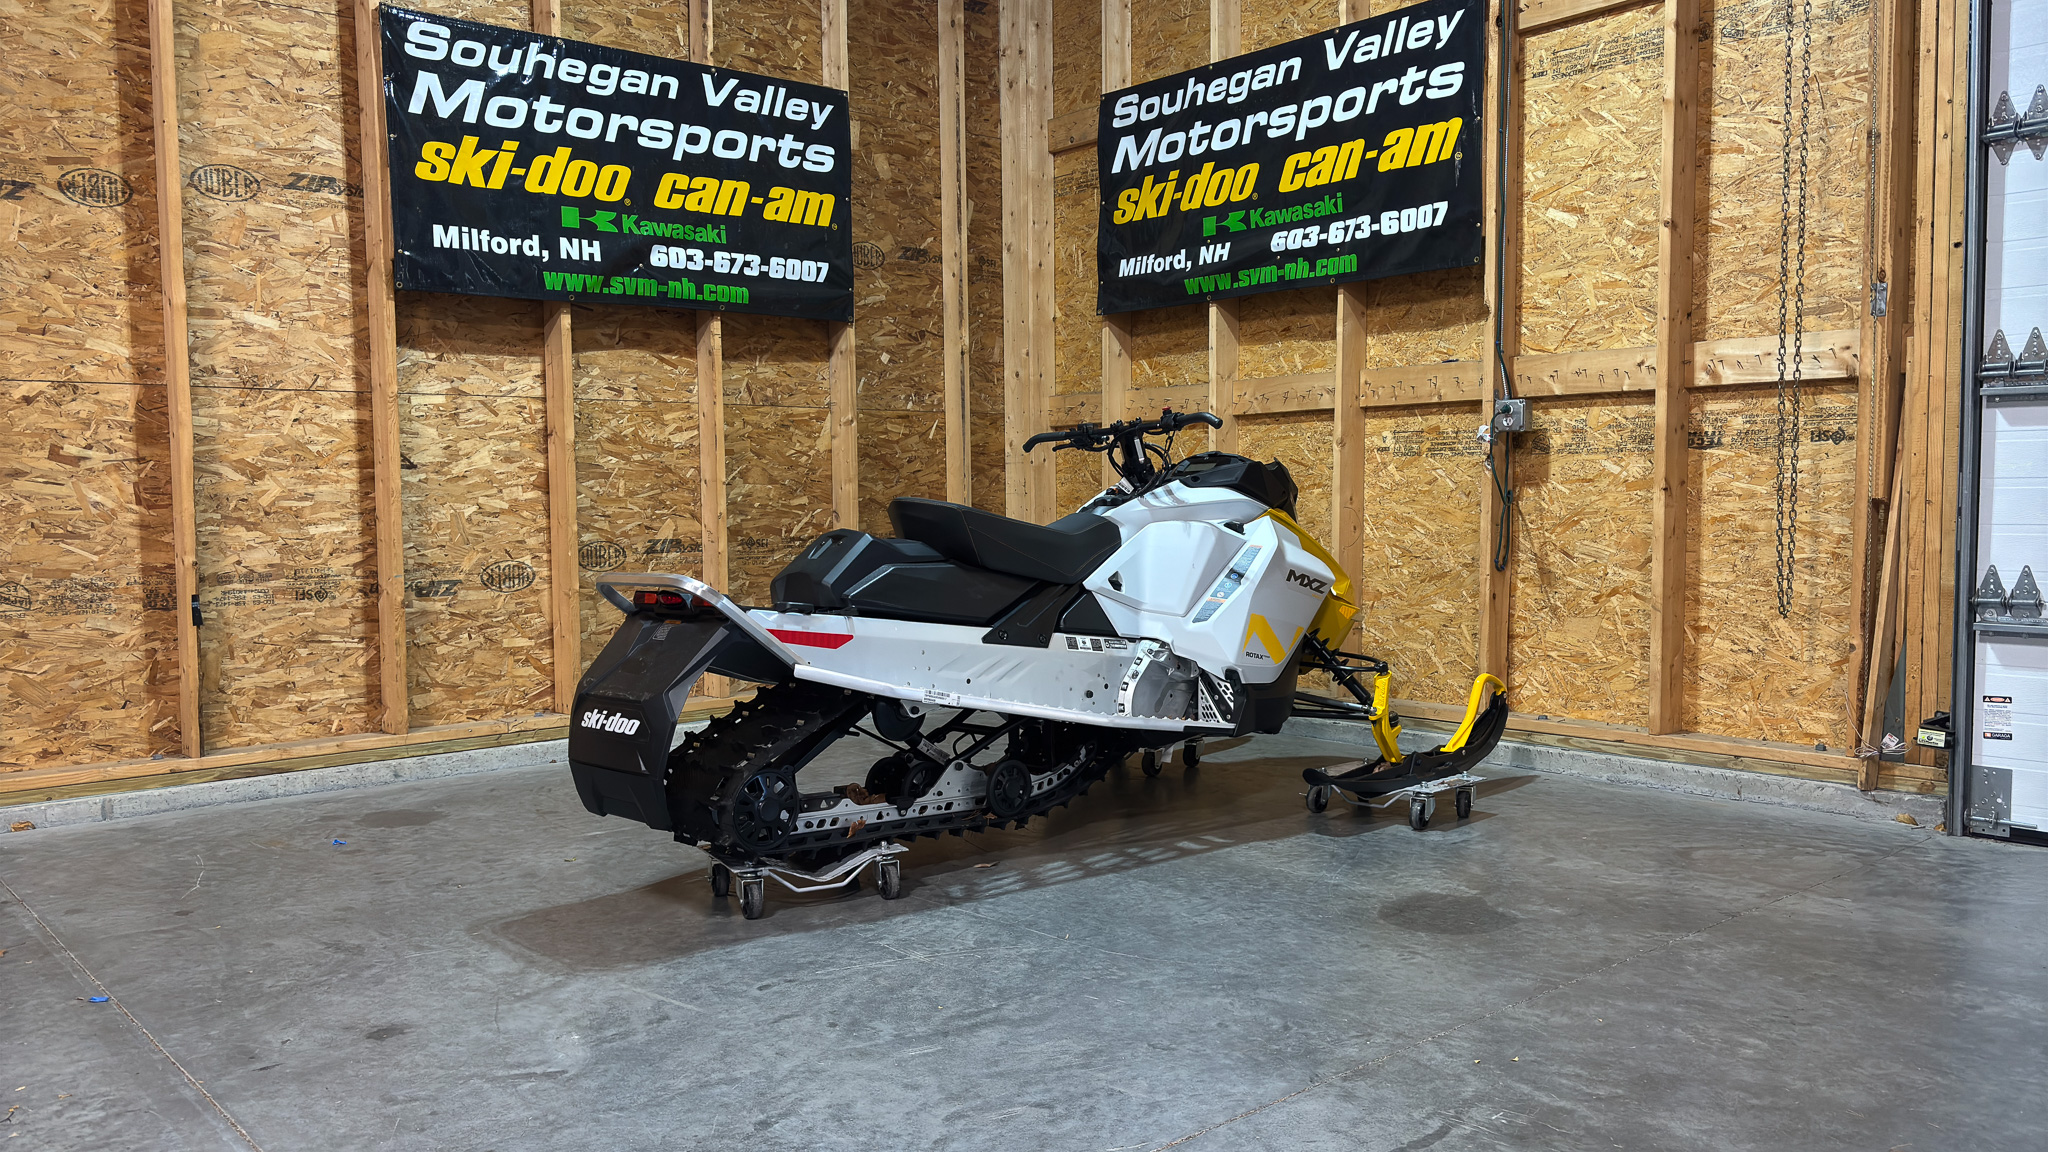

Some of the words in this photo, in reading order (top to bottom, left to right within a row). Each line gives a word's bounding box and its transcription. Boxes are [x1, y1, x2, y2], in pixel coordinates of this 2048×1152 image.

[403, 20, 679, 100] Souhegan
[702, 73, 835, 131] Valley
[1112, 56, 1303, 129] Souhegan
[1324, 9, 1466, 71] Valley
[407, 70, 836, 173] Motorsports
[1111, 62, 1466, 173] Motorsports
[196, 168, 255, 198] HUBER
[414, 136, 632, 202] ski-doo
[654, 173, 836, 229] can-am
[1114, 161, 1260, 225] ski-doo
[1279, 117, 1463, 193] can-am
[622, 214, 727, 245] Kawasaki
[1250, 193, 1344, 229] Kawasaki
[1271, 201, 1449, 253] 603-673-6007
[432, 223, 550, 263] Milford,
[559, 236, 603, 262] NH
[1118, 248, 1192, 278] Milford,
[1198, 241, 1231, 267] NH
[650, 244, 829, 283] 603-673-6007
[1184, 254, 1358, 296] www.svm-nh.com
[543, 271, 750, 305] www.svm-nh.com
[580, 544, 625, 570] HUBER
[1286, 568, 1328, 595] MXZ
[1245, 651, 1264, 660] ROTAX
[581, 708, 641, 735] ski-doo
